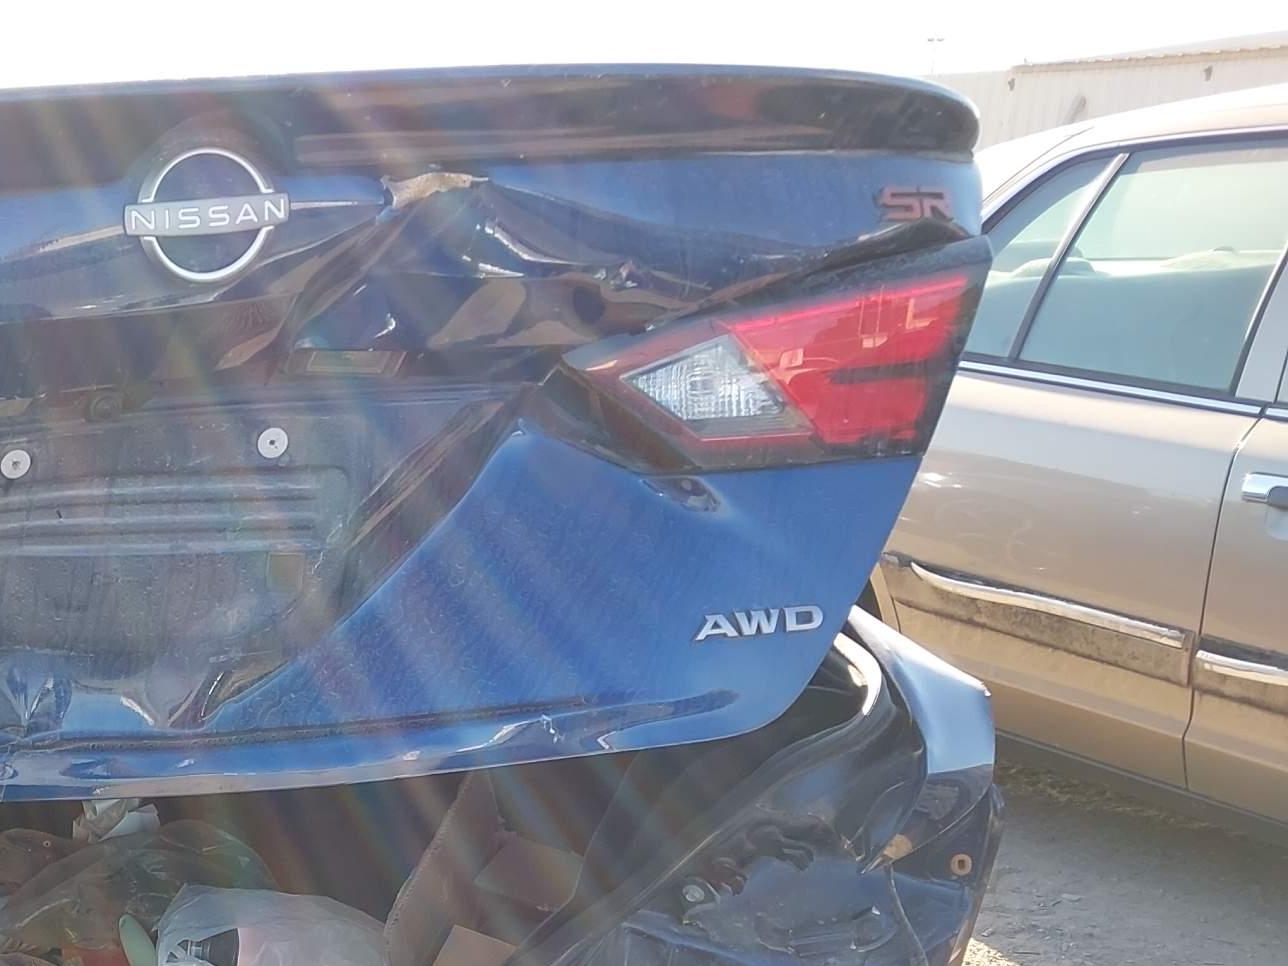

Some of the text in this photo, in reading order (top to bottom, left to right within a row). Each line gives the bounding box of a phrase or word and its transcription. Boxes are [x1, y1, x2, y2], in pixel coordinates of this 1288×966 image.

[130, 198, 286, 231] NISSAN
[876, 185, 955, 222] SR
[694, 605, 824, 641] AWD
